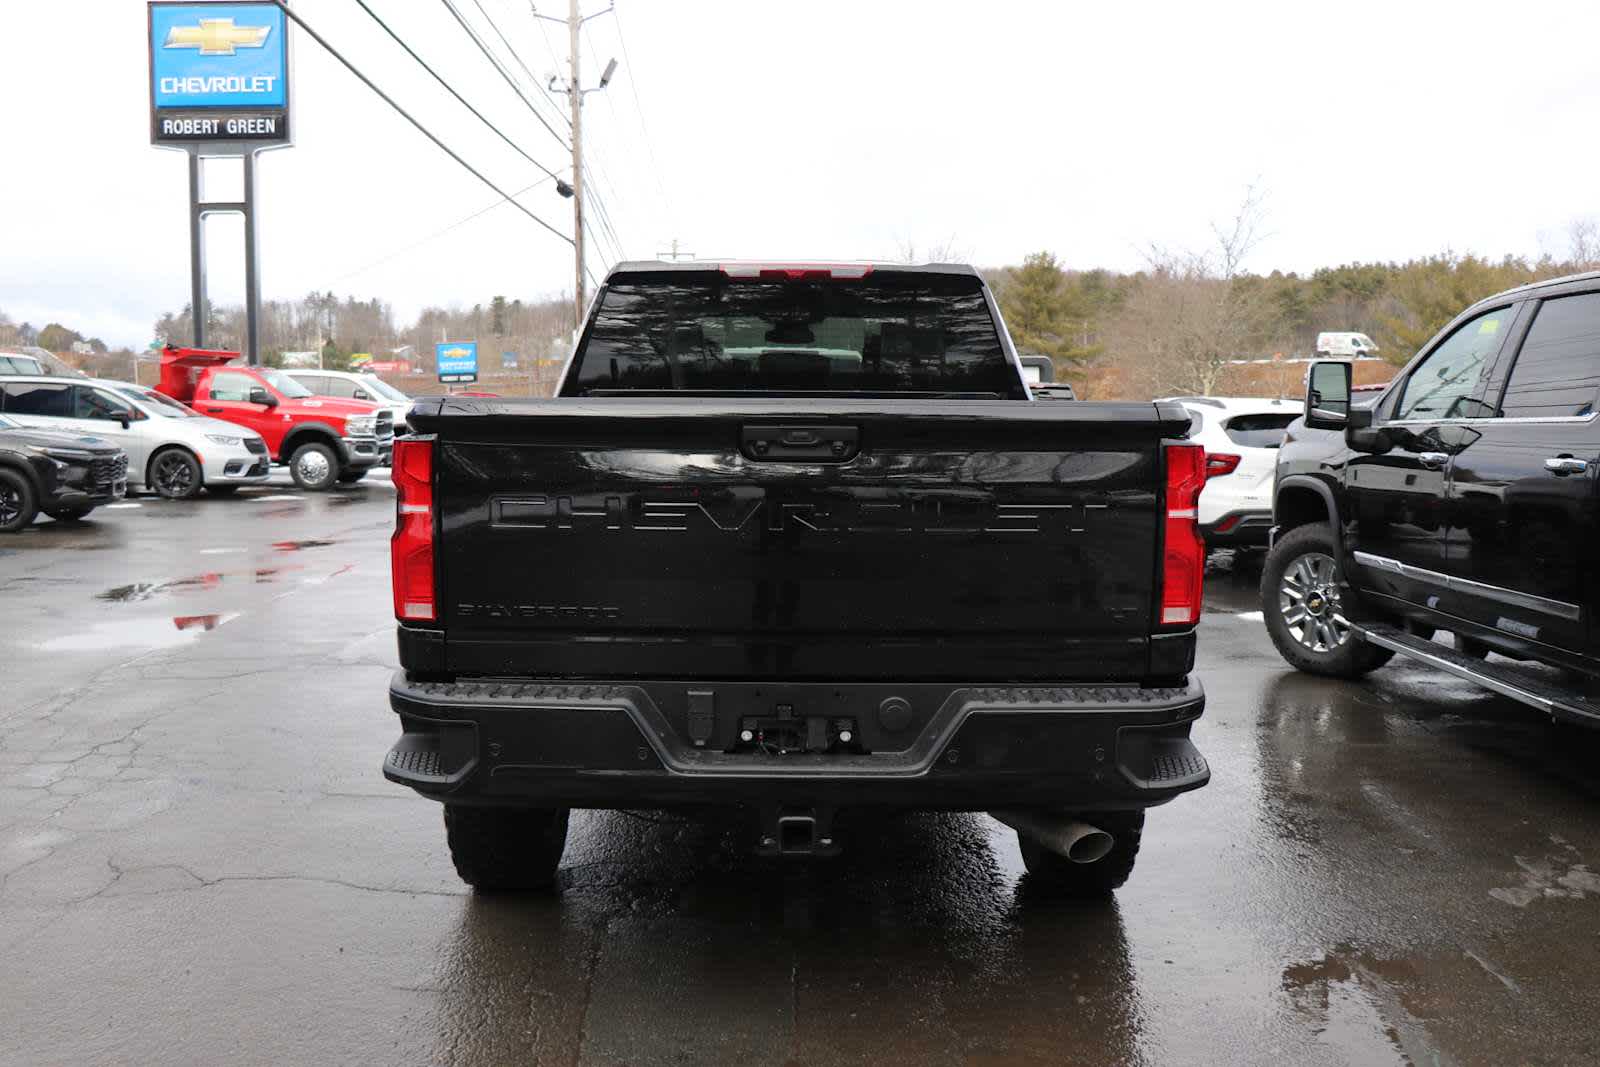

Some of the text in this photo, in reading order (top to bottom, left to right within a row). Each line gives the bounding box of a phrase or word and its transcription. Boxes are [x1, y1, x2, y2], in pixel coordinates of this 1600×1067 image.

[160, 76, 276, 93] CHEVROLET
[163, 119, 275, 134] ROBERT GREEN
[488, 495, 1109, 533] CHEVROLET
